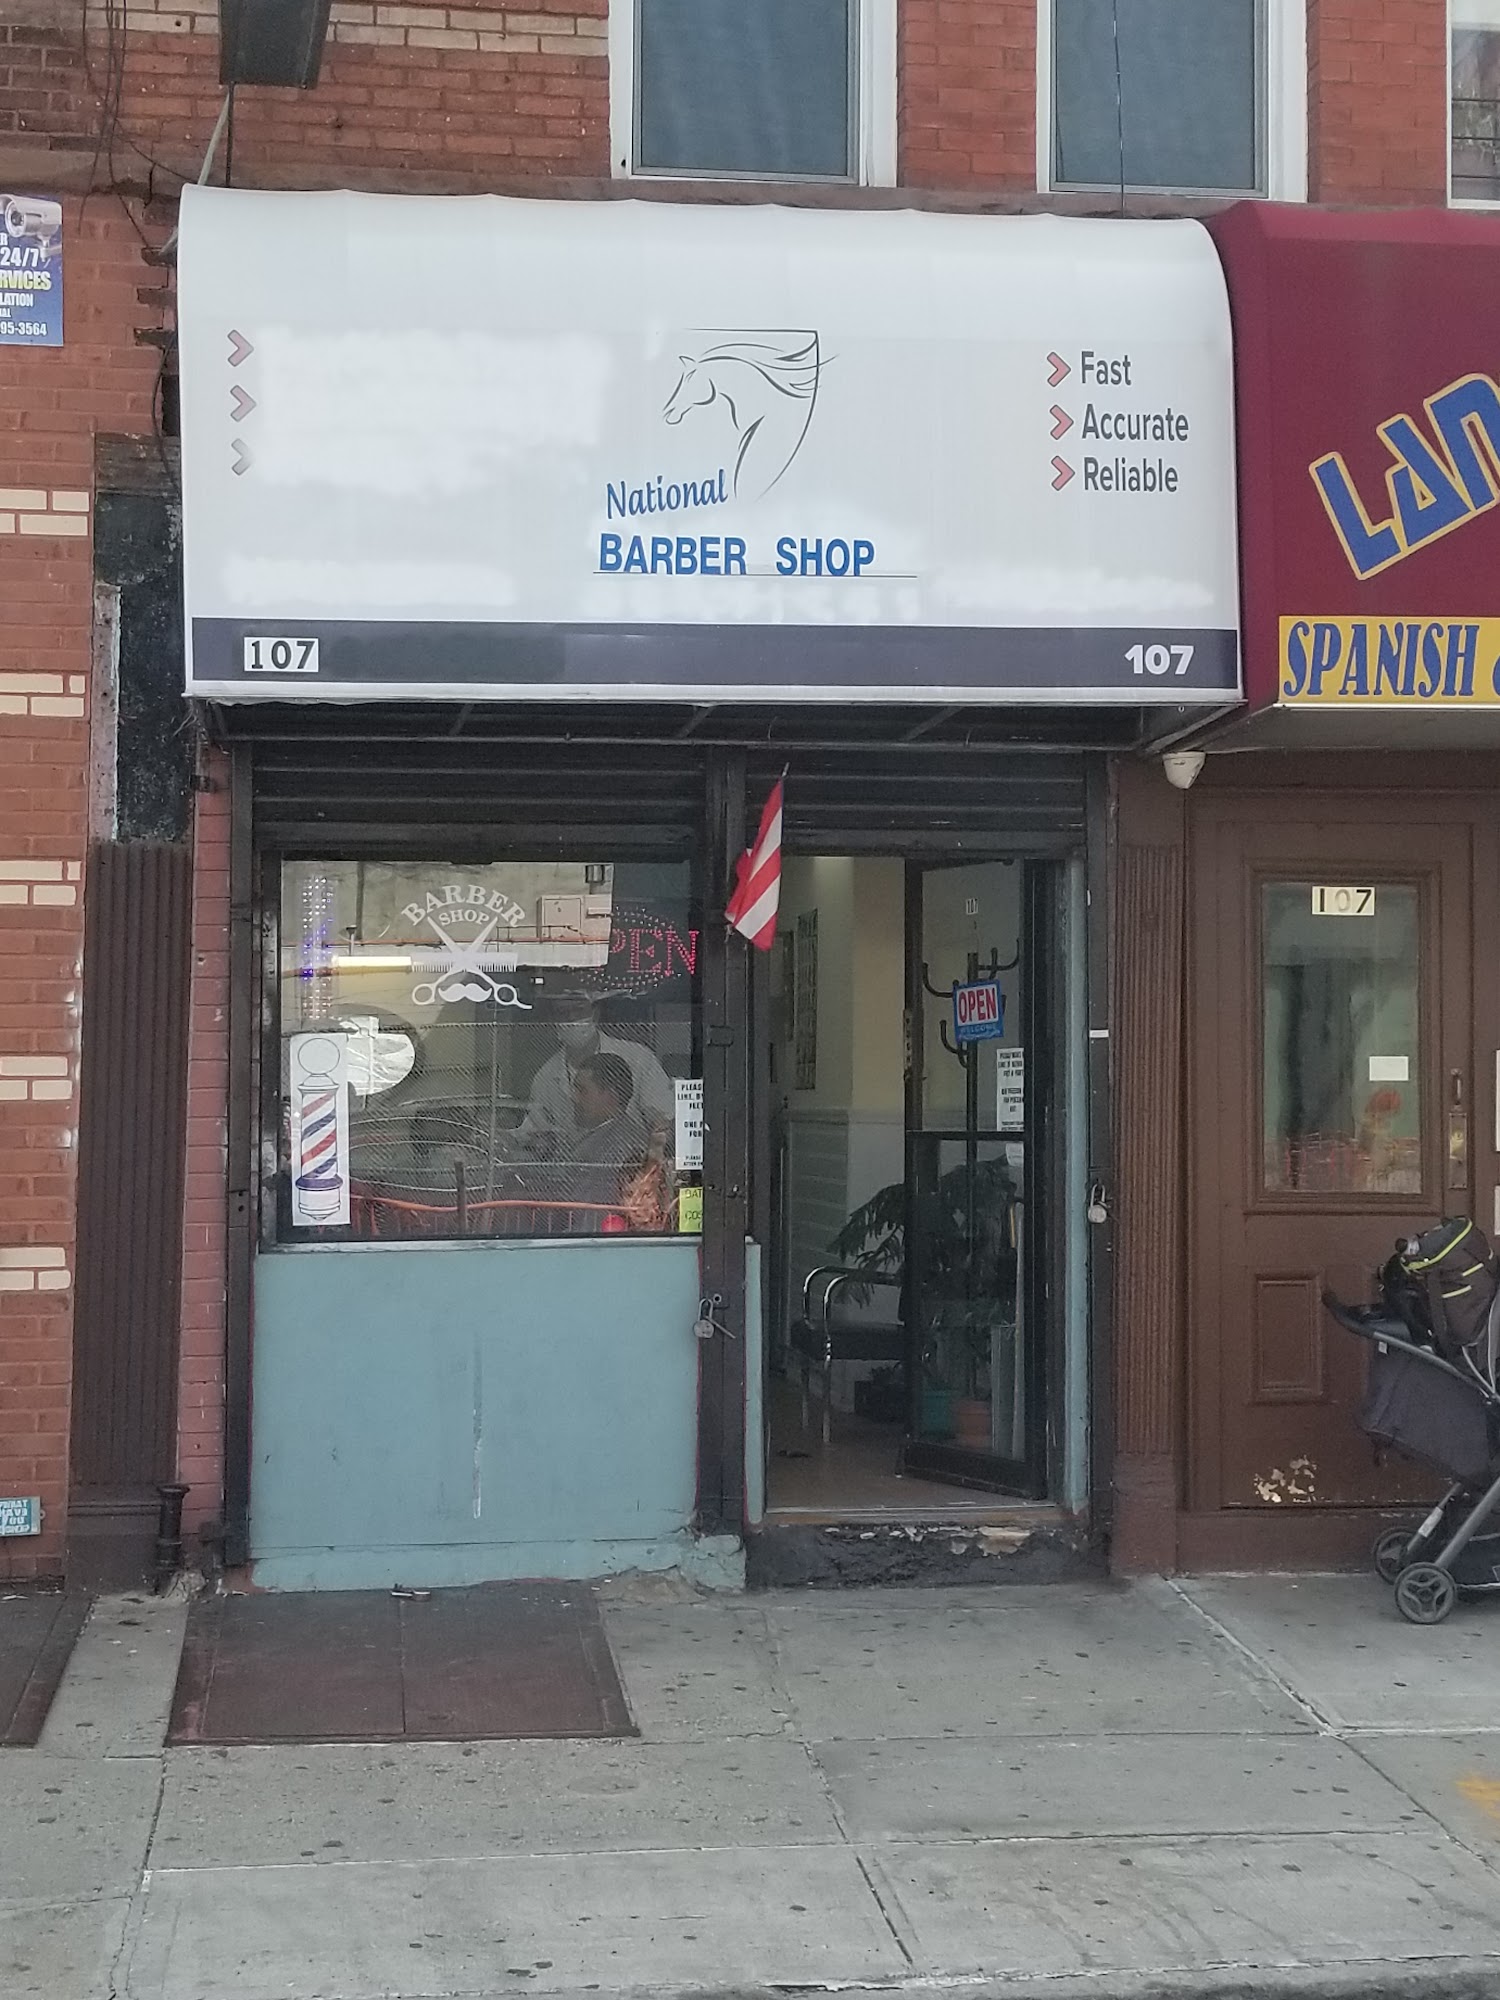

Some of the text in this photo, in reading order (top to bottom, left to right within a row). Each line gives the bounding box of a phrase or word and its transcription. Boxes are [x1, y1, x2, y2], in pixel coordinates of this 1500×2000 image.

[0, 246, 39, 268] 24/7
[0, 320, 47, 336] 95-3564
[1080, 350, 1132, 386] Fast
[1081, 403, 1190, 442] Accurate
[1083, 456, 1179, 493] Reliable
[605, 468, 729, 520] National
[600, 532, 876, 577] BARBER SHOP
[250, 640, 316, 670] 107
[1124, 644, 1195, 676] 107
[1283, 620, 1480, 698] SPANISH
[401, 884, 526, 928] BARBER
[438, 909, 490, 926] SHOP
[1317, 887, 1373, 914] 107
[958, 987, 998, 1024] OPEN
